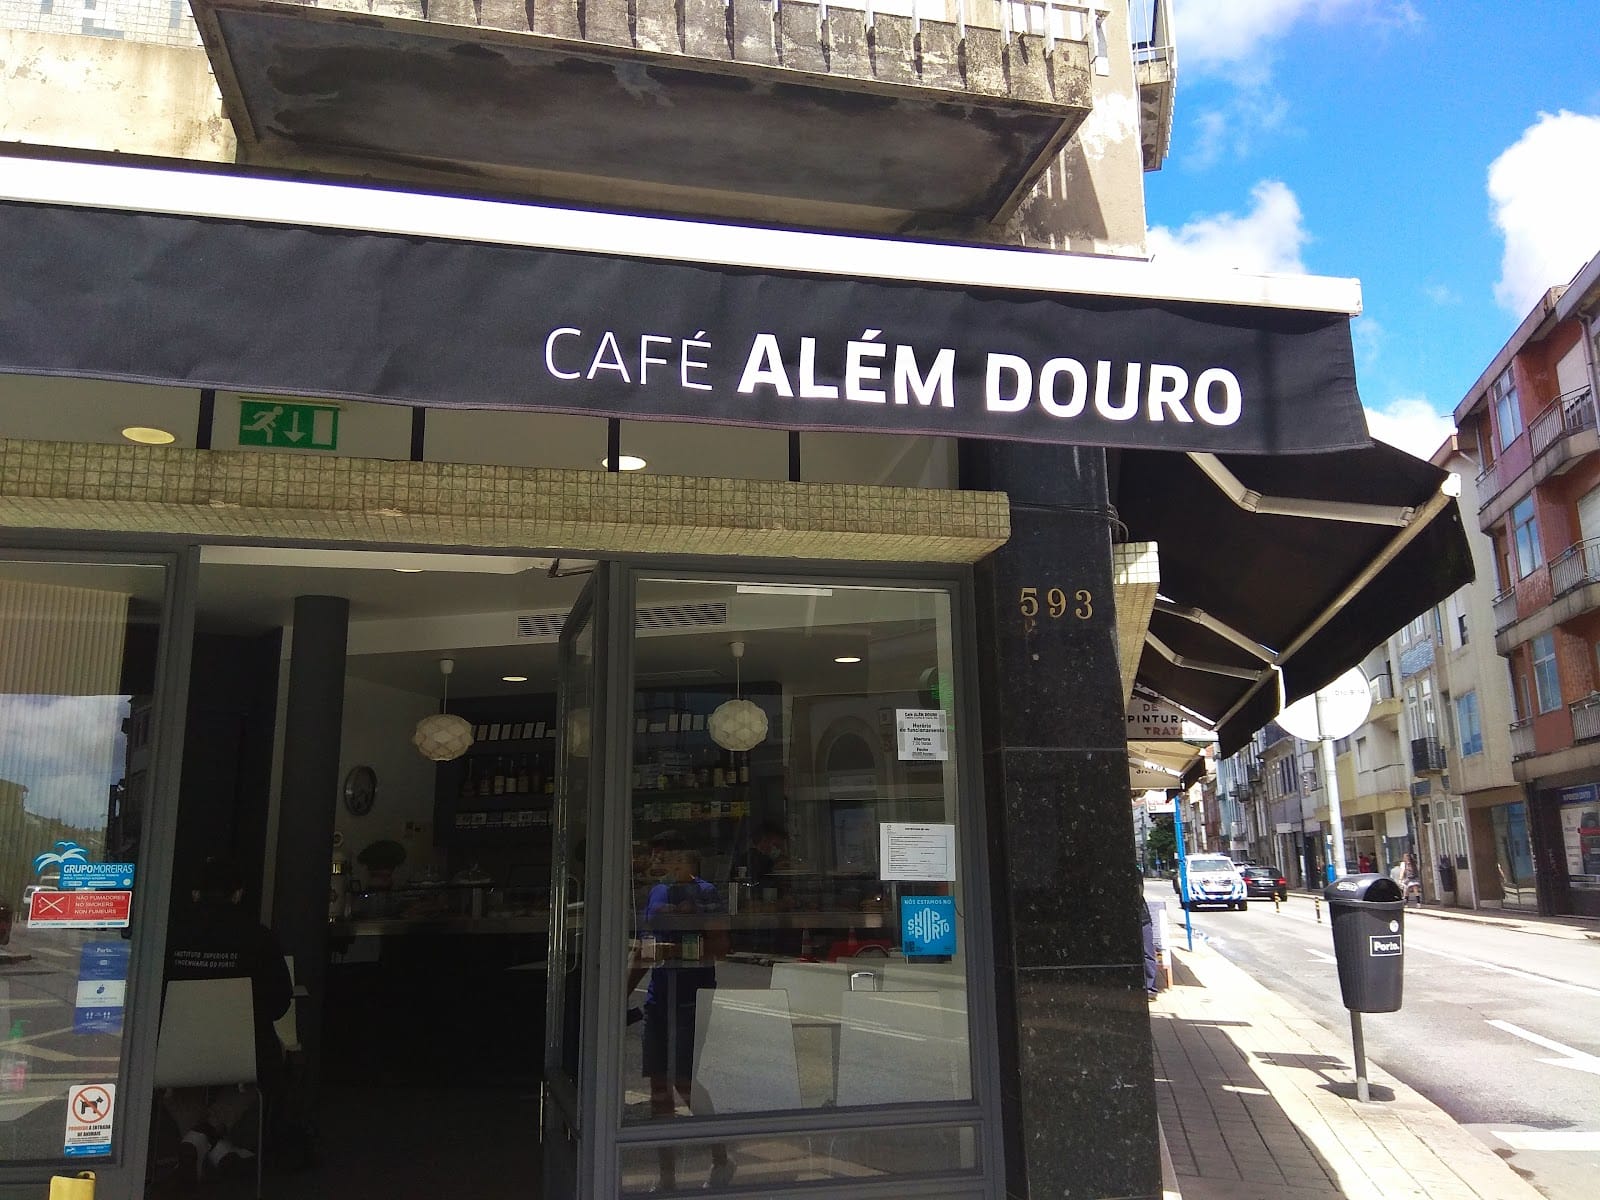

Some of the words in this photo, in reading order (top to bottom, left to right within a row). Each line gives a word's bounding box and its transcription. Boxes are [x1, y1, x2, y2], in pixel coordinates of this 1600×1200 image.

[545, 328, 713, 391] CAFÉ
[737, 329, 956, 408] ALÉM
[986, 352, 1242, 426] DOURO
[1020, 587, 1093, 619] 593
[1143, 704, 1159, 712] DE
[63, 864, 133, 873] GRUPOMOREIRAS
